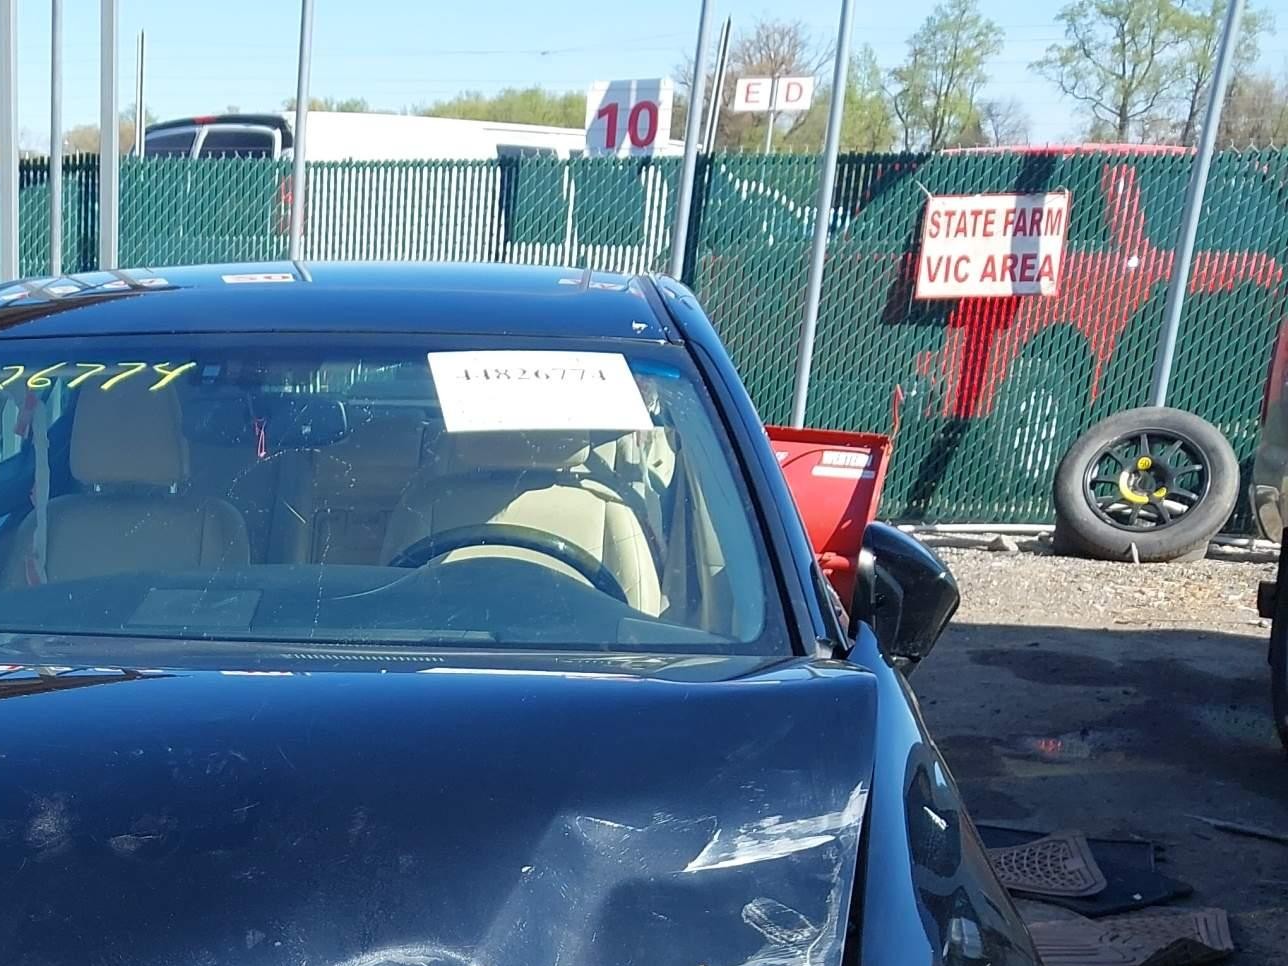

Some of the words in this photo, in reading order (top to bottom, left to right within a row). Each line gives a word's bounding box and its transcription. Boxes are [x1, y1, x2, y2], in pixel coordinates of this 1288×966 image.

[744, 82, 762, 104] E
[785, 82, 804, 103] D
[598, 101, 659, 149] 10
[928, 208, 996, 239] STATE
[1003, 206, 1064, 237] FARM
[926, 254, 971, 284] VIC
[980, 253, 1055, 282] AREA
